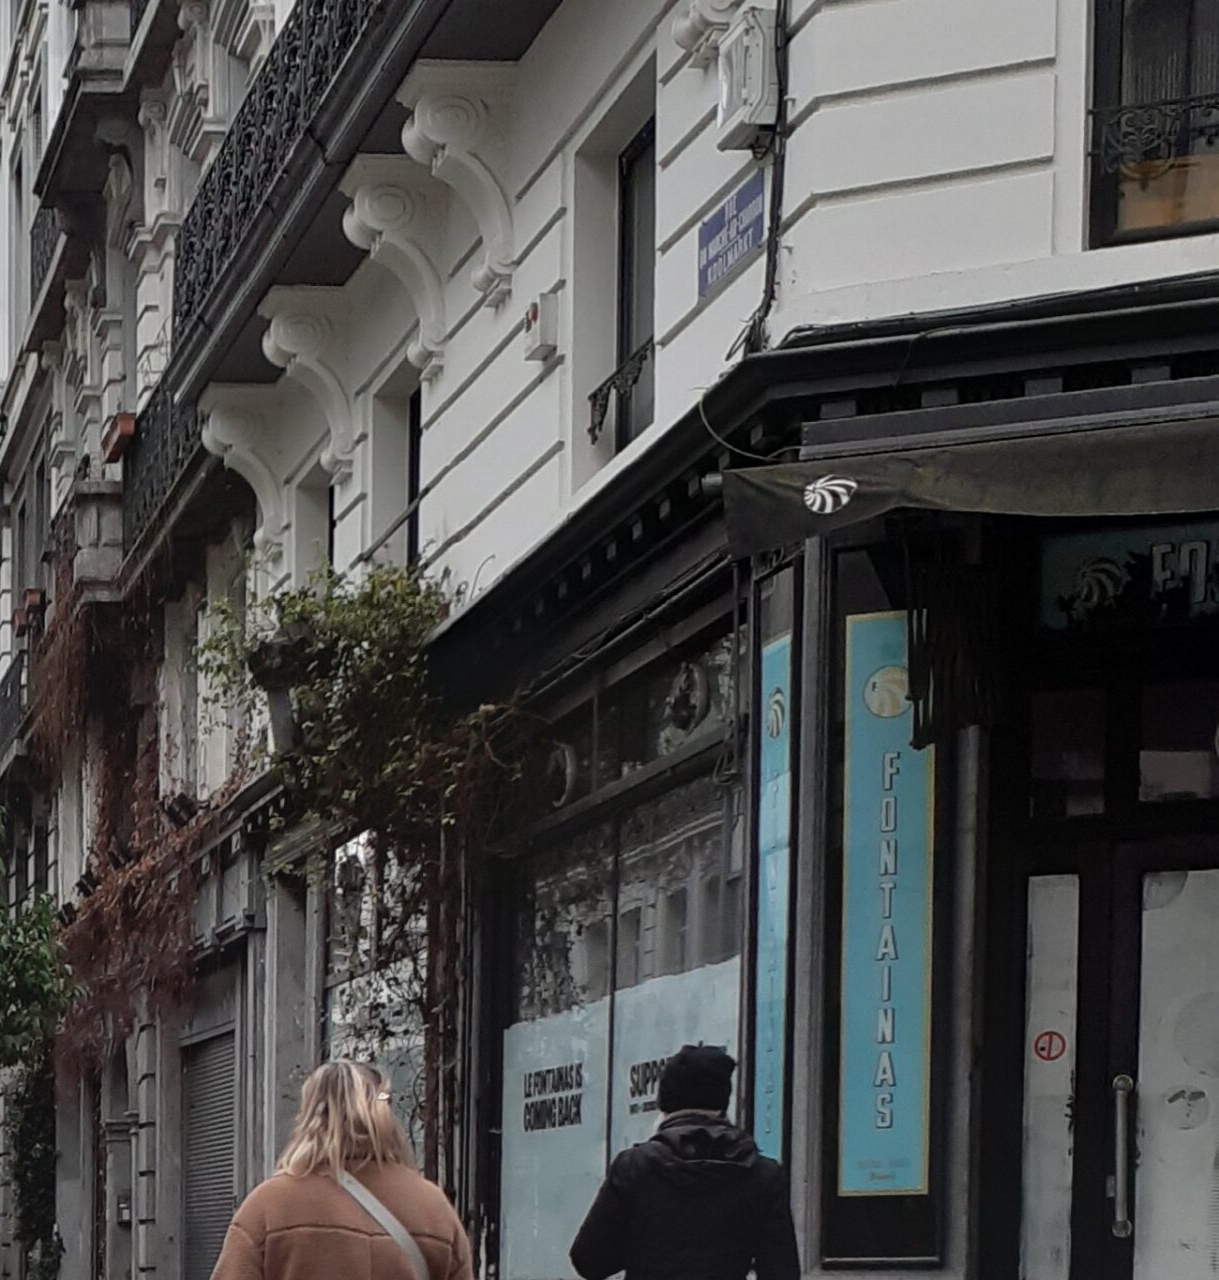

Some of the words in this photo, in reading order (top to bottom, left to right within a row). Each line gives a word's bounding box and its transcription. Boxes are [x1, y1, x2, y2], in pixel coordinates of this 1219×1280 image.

[1151, 540, 1219, 605] FO
[875, 751, 901, 1130] FONTAINAS
[524, 1072, 533, 1098] LE
[534, 1064, 574, 1096] FONTAINAS
[575, 1062, 582, 1090] IS
[629, 1056, 669, 1098] SUPP
[523, 1098, 557, 1132] COMING
[558, 1093, 583, 1127] BACK
